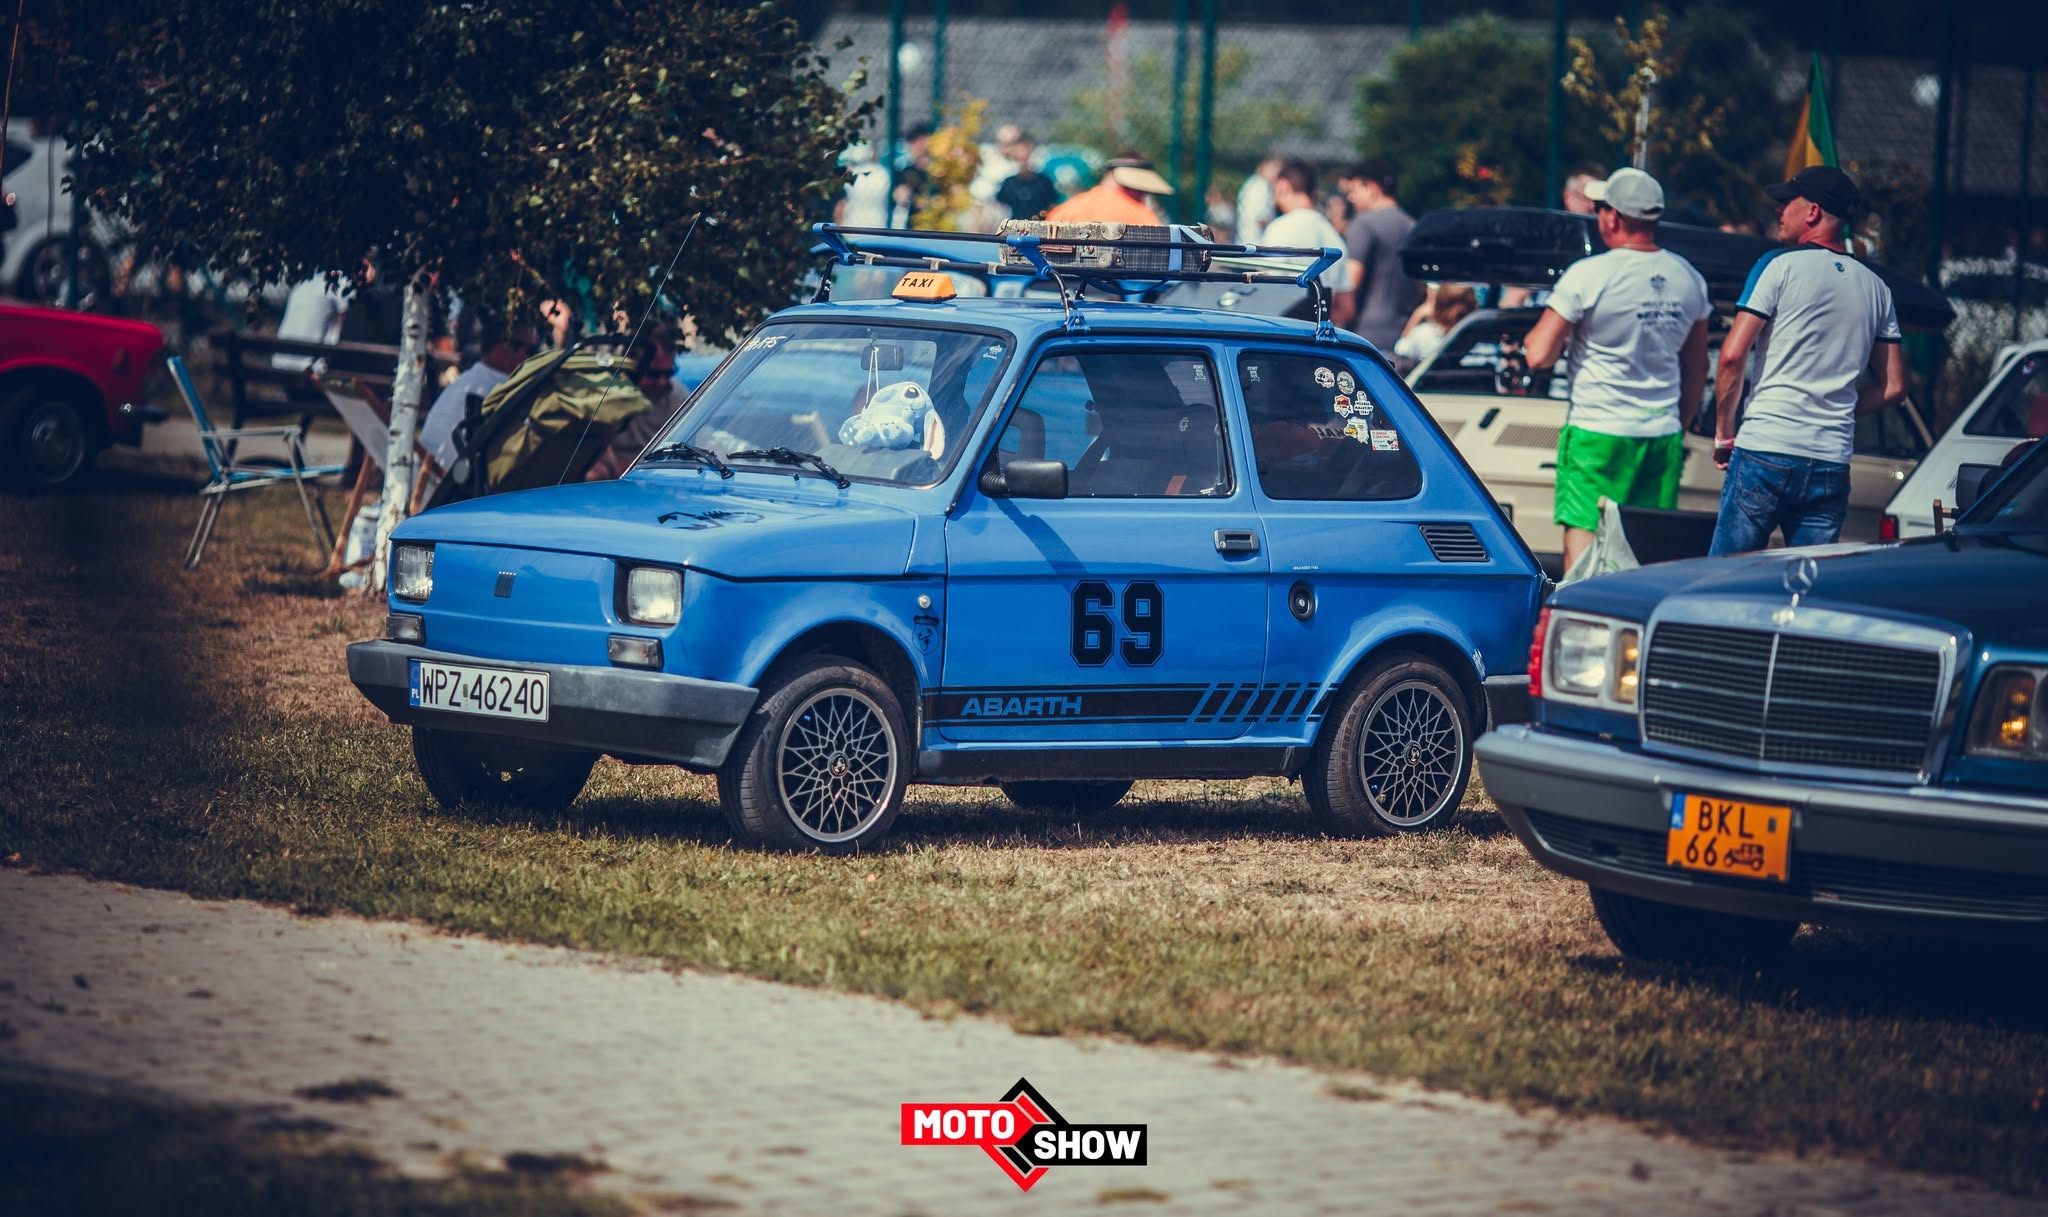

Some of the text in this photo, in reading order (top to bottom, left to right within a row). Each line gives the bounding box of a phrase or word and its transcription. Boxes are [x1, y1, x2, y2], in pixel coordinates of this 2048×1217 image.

[901, 277, 934, 288] TAXI
[1070, 579, 1165, 668] 69
[411, 688, 420, 699] PL
[422, 667, 544, 715] WPZ 46240
[960, 696, 1083, 717] ABARTH
[1698, 800, 1755, 839] BKL
[1686, 834, 1717, 867] 66
